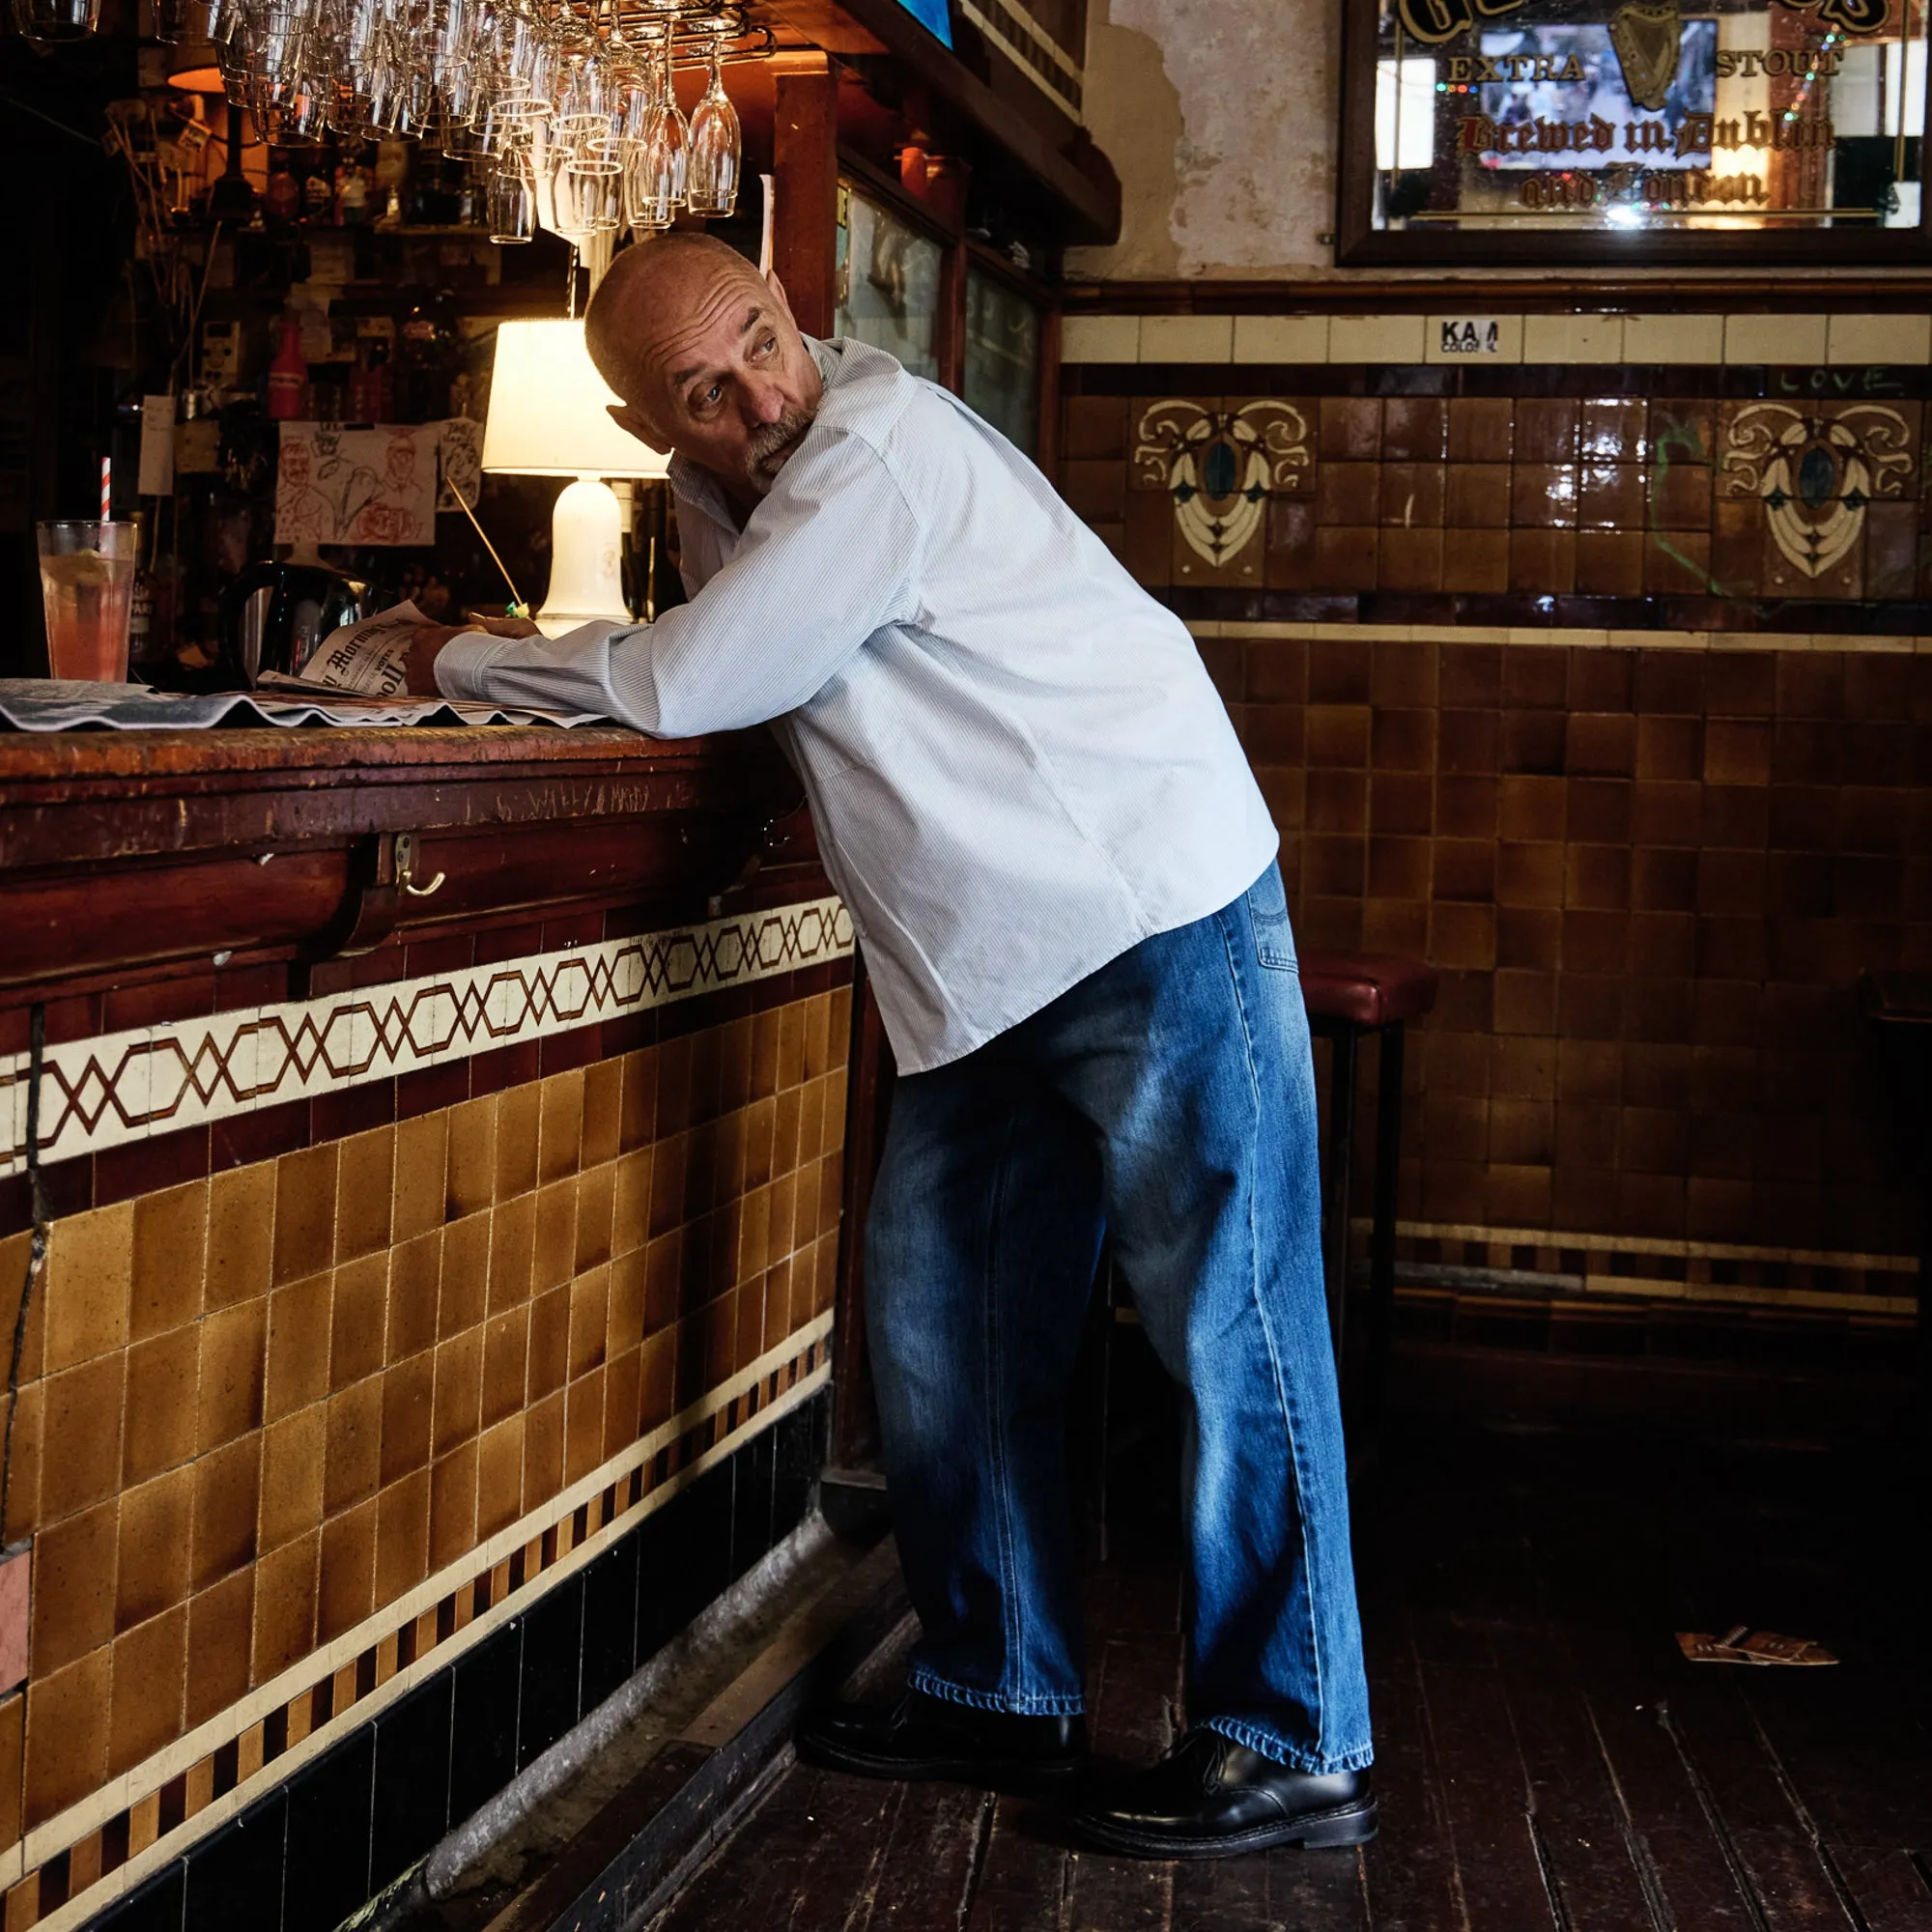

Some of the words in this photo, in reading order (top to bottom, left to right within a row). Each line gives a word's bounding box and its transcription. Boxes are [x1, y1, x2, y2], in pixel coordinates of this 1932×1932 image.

[1449, 54, 1586, 82] EXTRA
[1716, 49, 1845, 77] STOUT
[1456, 113, 1614, 155] Brewed
[1624, 117, 1675, 153] in
[1675, 106, 1835, 158] Dublin
[1520, 168, 1597, 209] and
[1780, 366, 1903, 391] LOVE
[326, 621, 388, 676] Morning
[374, 648, 395, 671] VOTES
